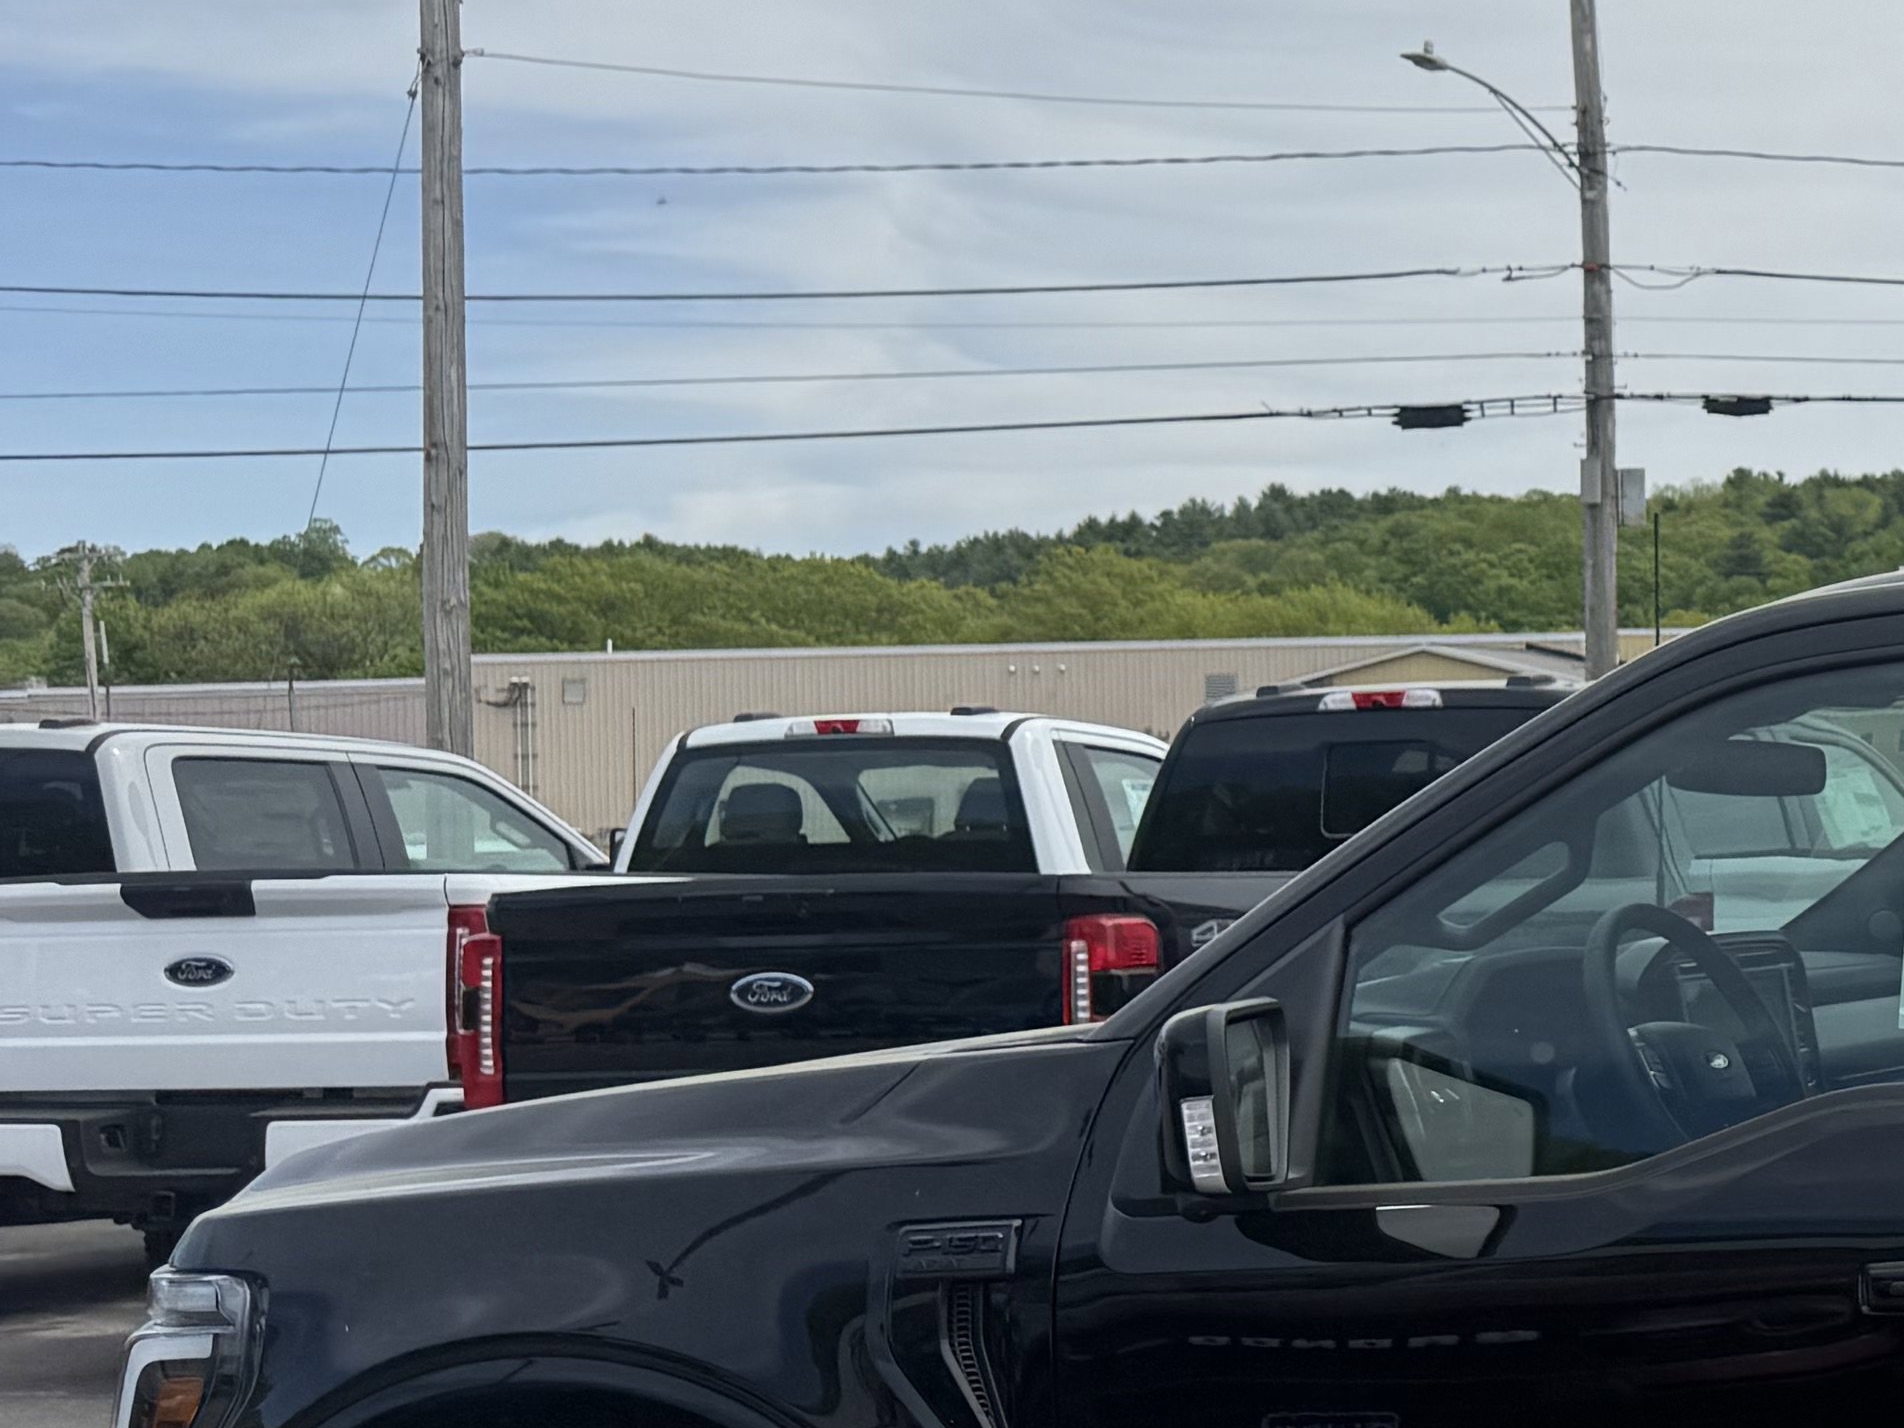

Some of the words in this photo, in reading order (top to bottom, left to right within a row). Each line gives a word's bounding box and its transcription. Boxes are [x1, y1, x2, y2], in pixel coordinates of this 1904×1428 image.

[0, 1000, 215, 1026] SUPER
[233, 998, 416, 1022] DUTY
[902, 1231, 1005, 1257] F-150
